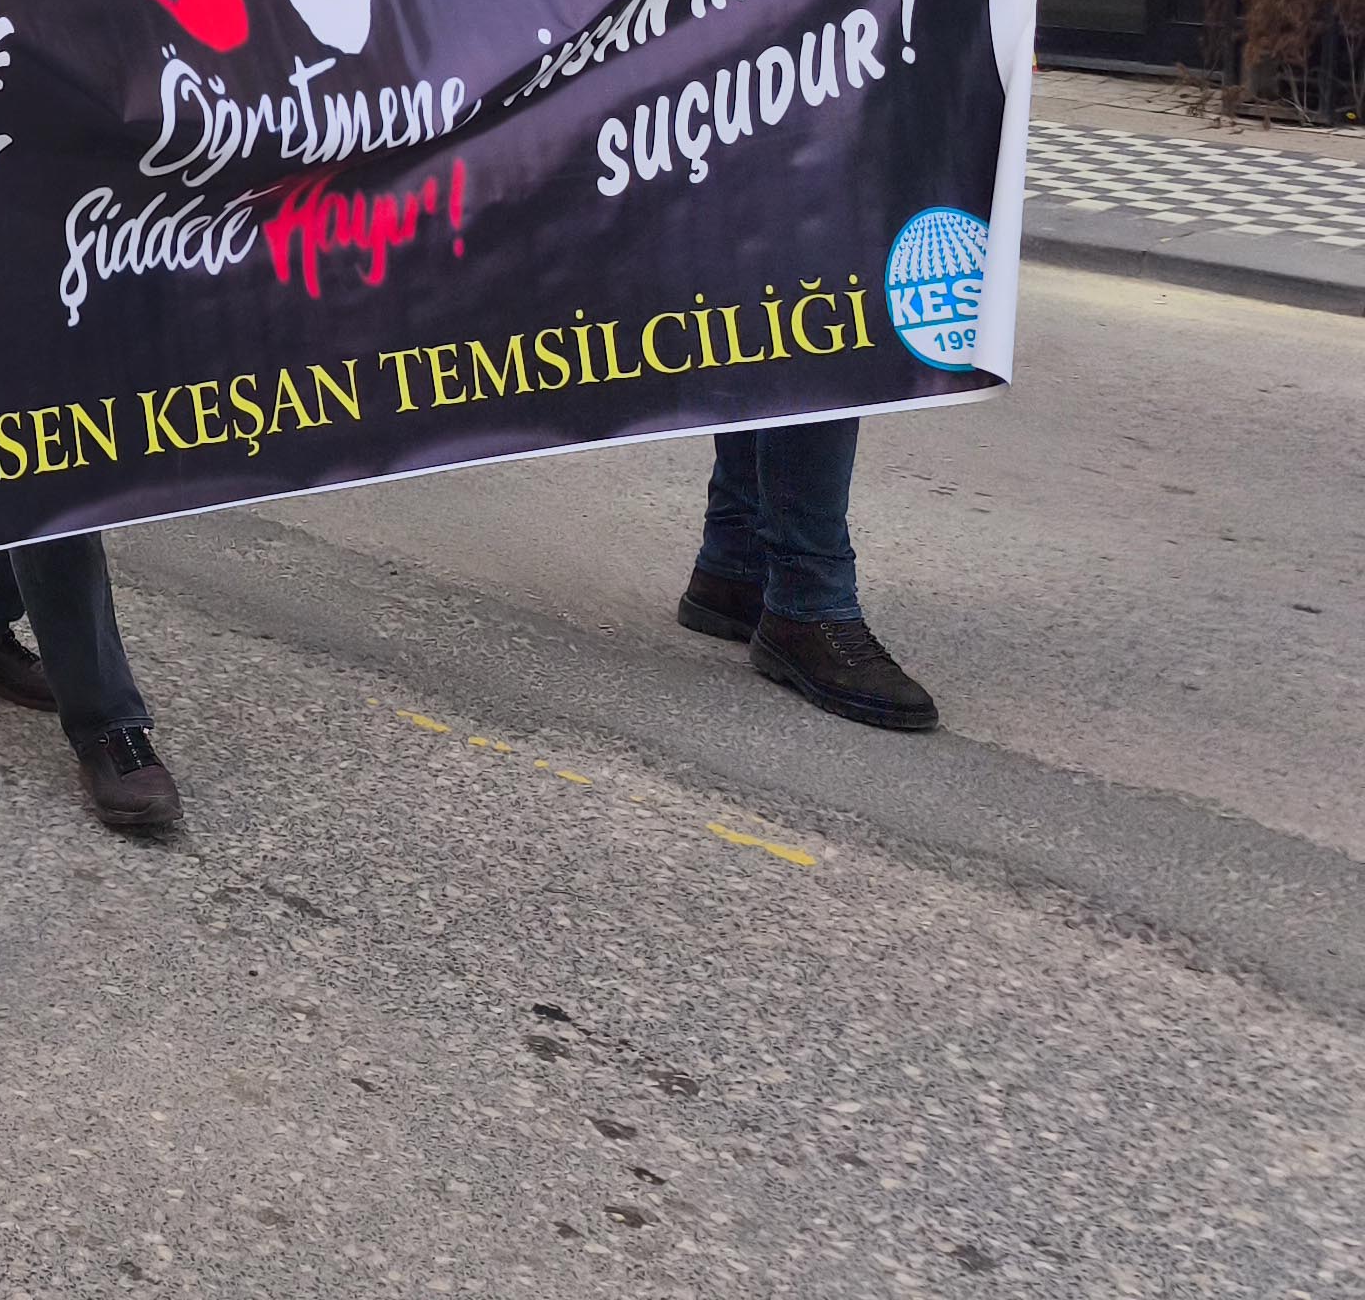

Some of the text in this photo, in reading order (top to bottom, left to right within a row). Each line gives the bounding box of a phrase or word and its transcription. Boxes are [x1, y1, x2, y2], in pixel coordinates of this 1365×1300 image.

[595, 7, 886, 198] SUÇUDUR
[143, 359, 363, 458] KEŞAN
[378, 274, 876, 414] TEMSİLCİLİĞİ
[889, 278, 982, 327] KES
